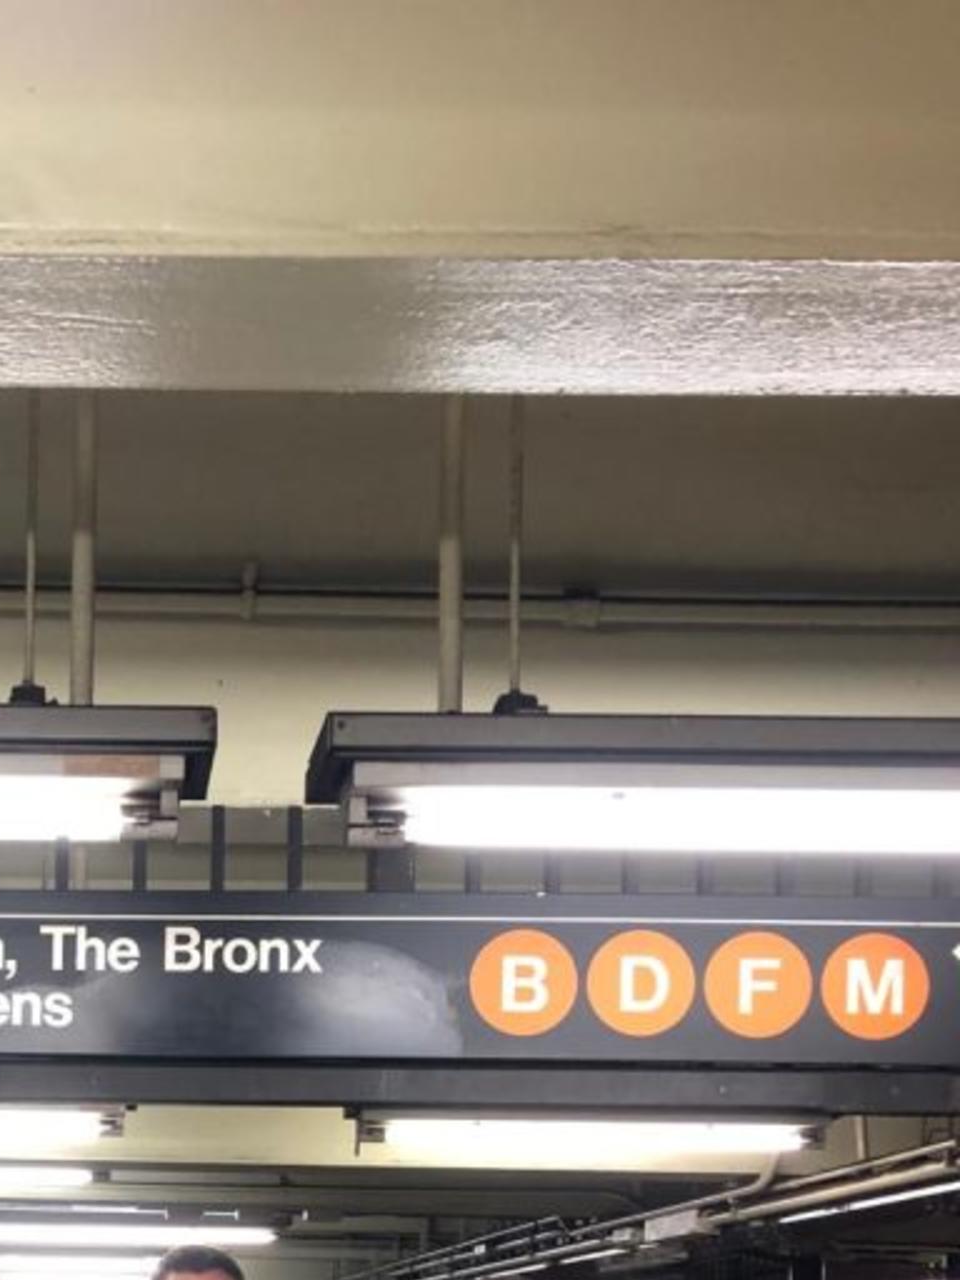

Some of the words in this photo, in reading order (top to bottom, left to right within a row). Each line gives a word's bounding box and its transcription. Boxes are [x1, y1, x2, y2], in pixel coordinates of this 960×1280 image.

[39, 925, 140, 973] The
[164, 927, 323, 973] Bronx
[501, 954, 550, 1013] B
[618, 955, 671, 1013] D
[739, 958, 781, 1015] F
[846, 959, 904, 1015] M
